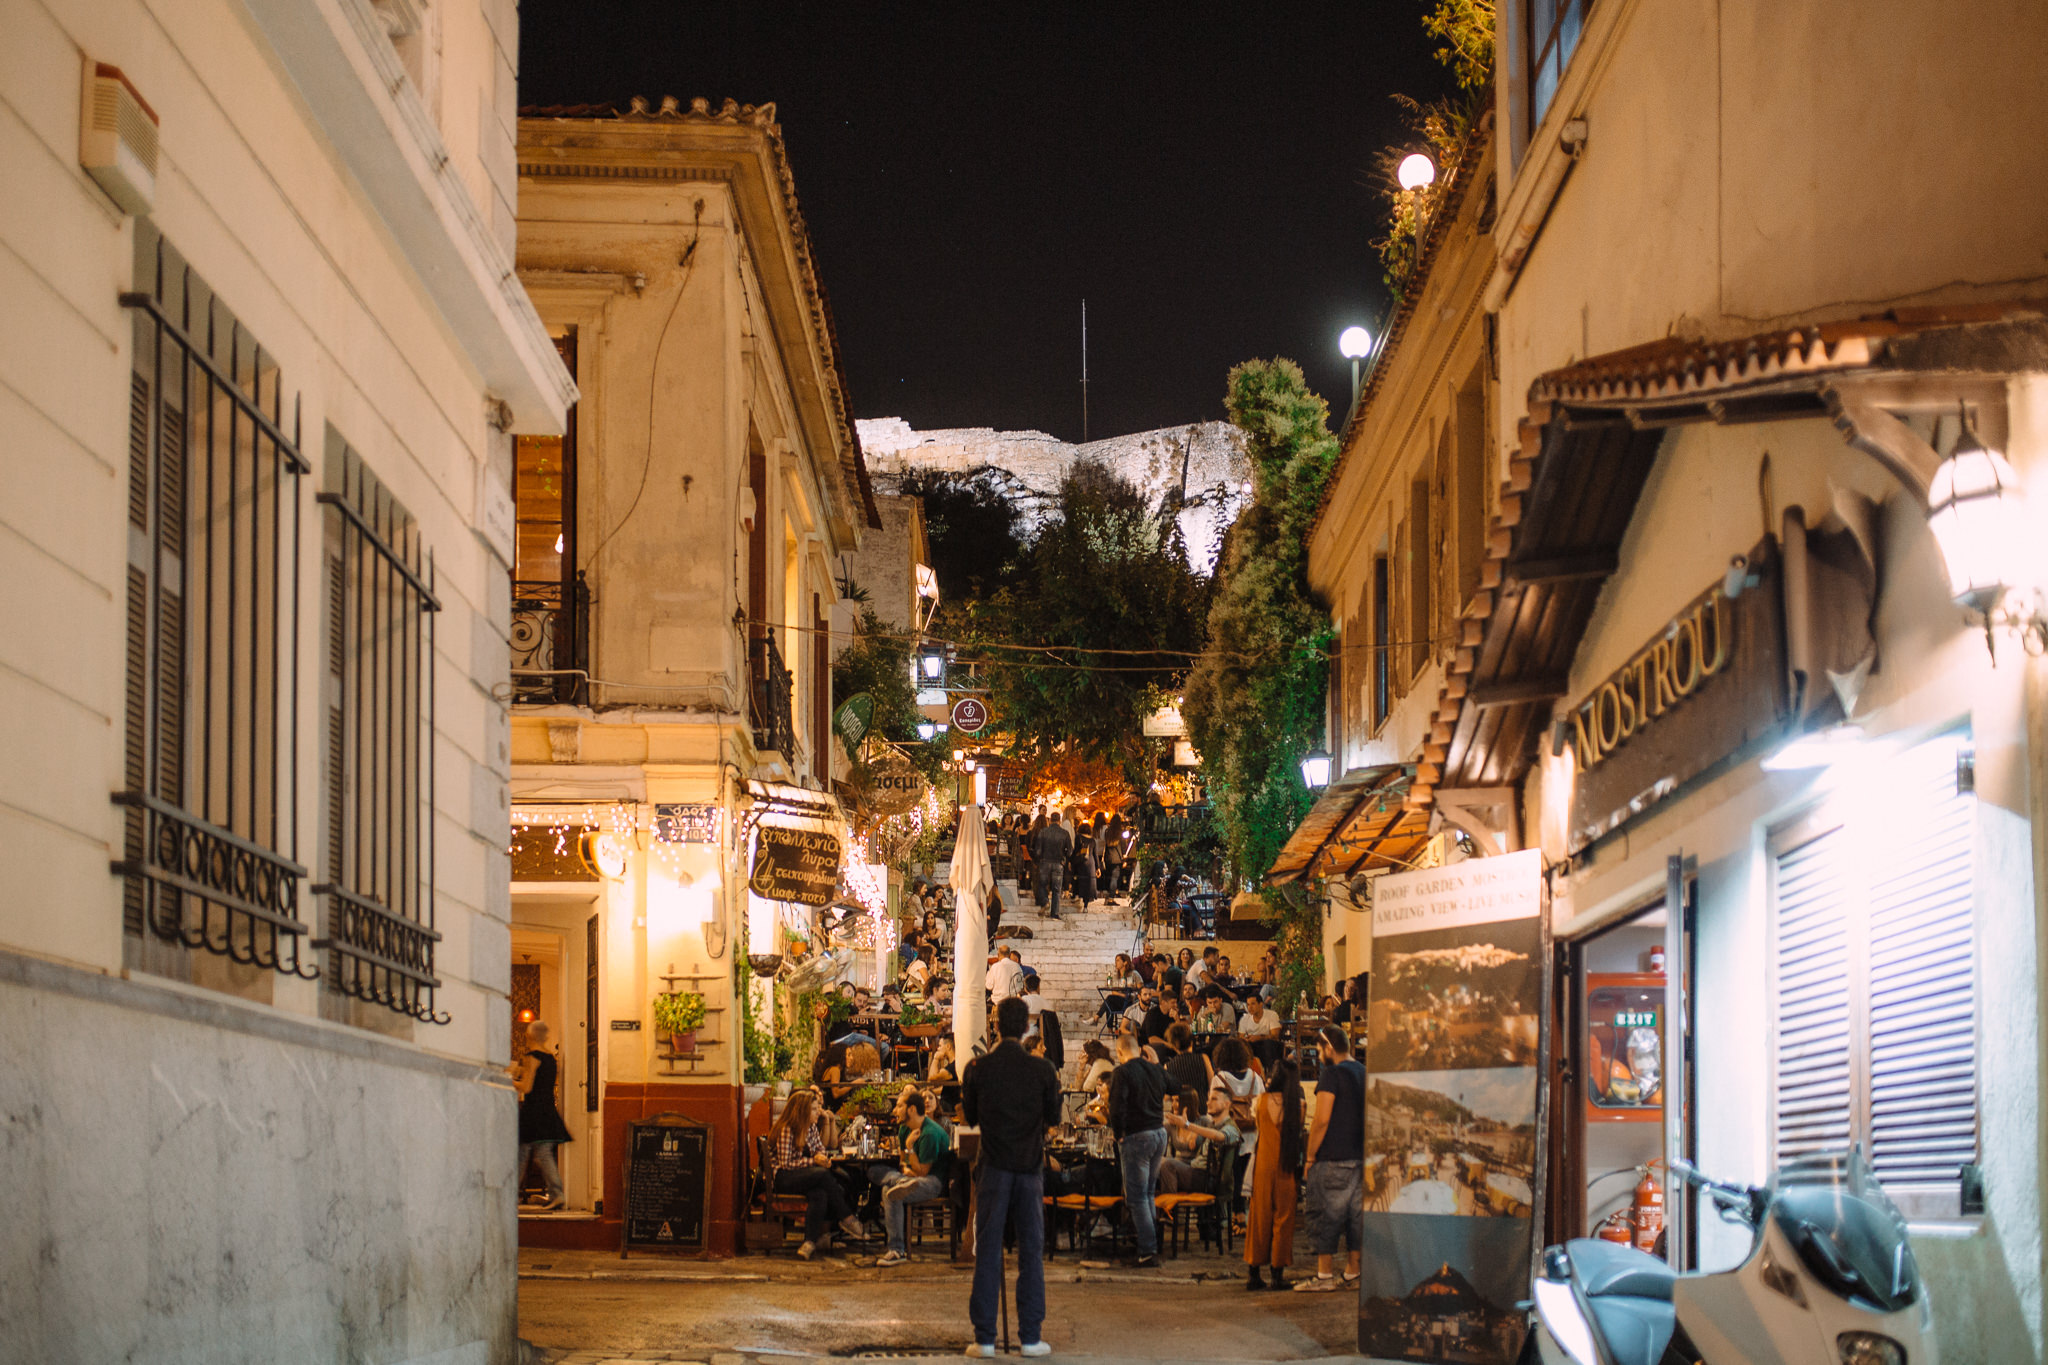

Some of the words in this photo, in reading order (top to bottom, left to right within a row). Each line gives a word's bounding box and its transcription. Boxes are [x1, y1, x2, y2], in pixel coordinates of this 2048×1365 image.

[1576, 590, 1721, 772] MOSTROU
[672, 817, 709, 827] ΛΥΣΙΥ
[800, 849, 837, 870] λύρα
[1380, 885, 1411, 902] ROOF
[1416, 877, 1466, 897] GARDEN
[1376, 905, 1425, 924] AMAZING
[1468, 895, 1495, 911] LIVE
[1616, 1013, 1653, 1025] EXIT
